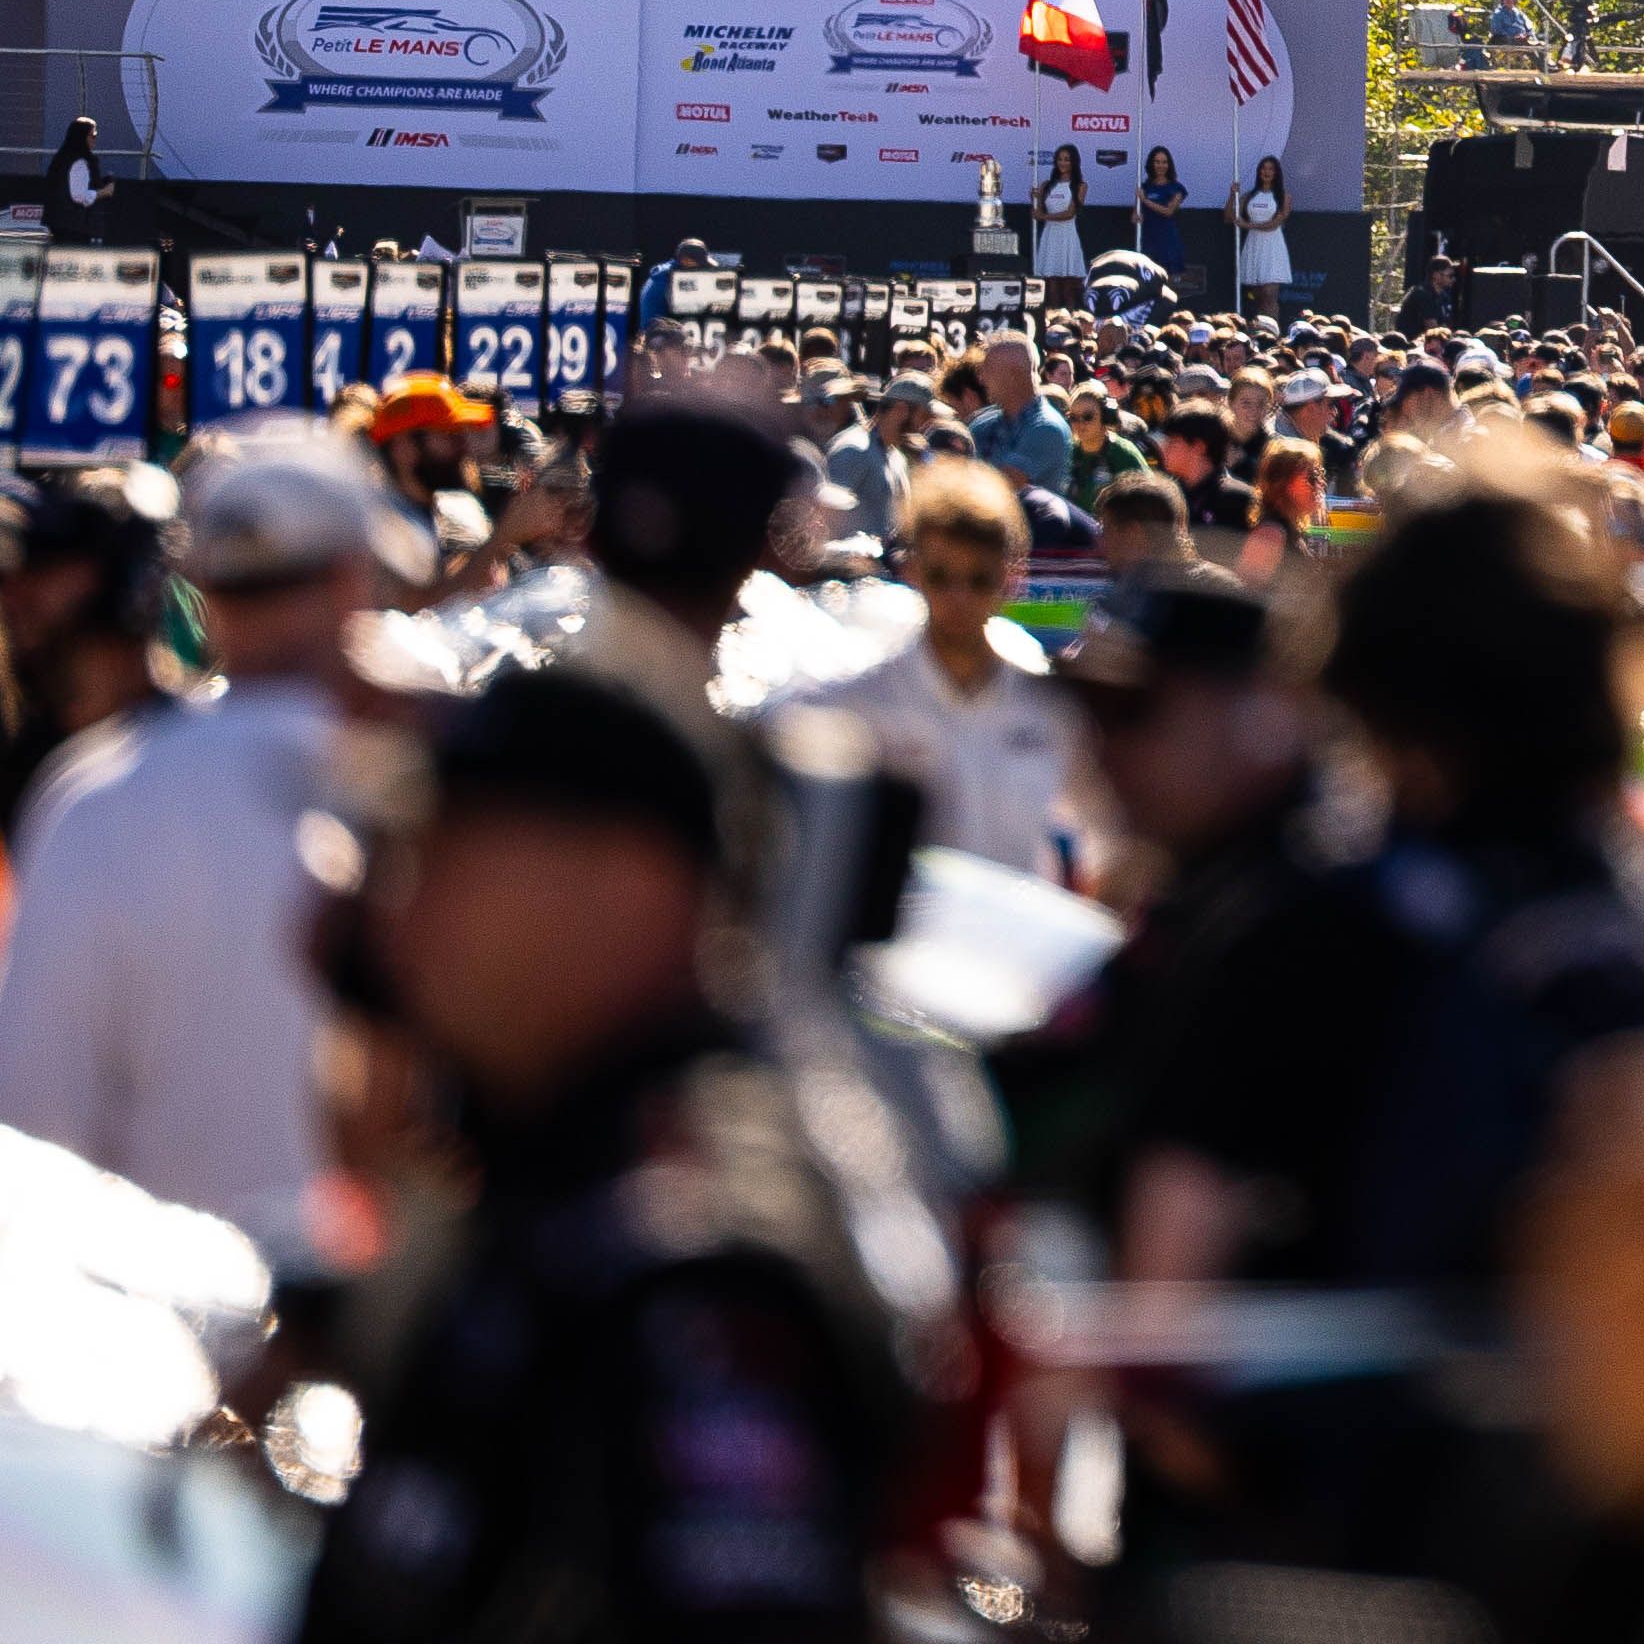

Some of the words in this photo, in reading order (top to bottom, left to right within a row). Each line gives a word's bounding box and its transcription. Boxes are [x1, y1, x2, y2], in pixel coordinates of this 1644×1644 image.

[683, 25, 796, 40] MICHELIN
[312, 38, 352, 53] Petit
[353, 39, 384, 54] LE
[388, 40, 460, 56] MANS
[719, 42, 788, 51] RACEWAY
[308, 84, 353, 96] WHERE
[356, 85, 435, 98] CHAMPIONS
[436, 87, 462, 99] ARE
[463, 88, 503, 101] MADE
[680, 106, 728, 120] MOTUL
[767, 108, 879, 123] WeatherTech
[918, 114, 1031, 128] WeatherTech
[1074, 116, 1128, 131] MOTUL
[394, 132, 449, 147] IMSA
[381, 326, 416, 396] 2
[467, 325, 534, 388] 22
[213, 326, 288, 408] 18
[46, 332, 136, 425] 73
